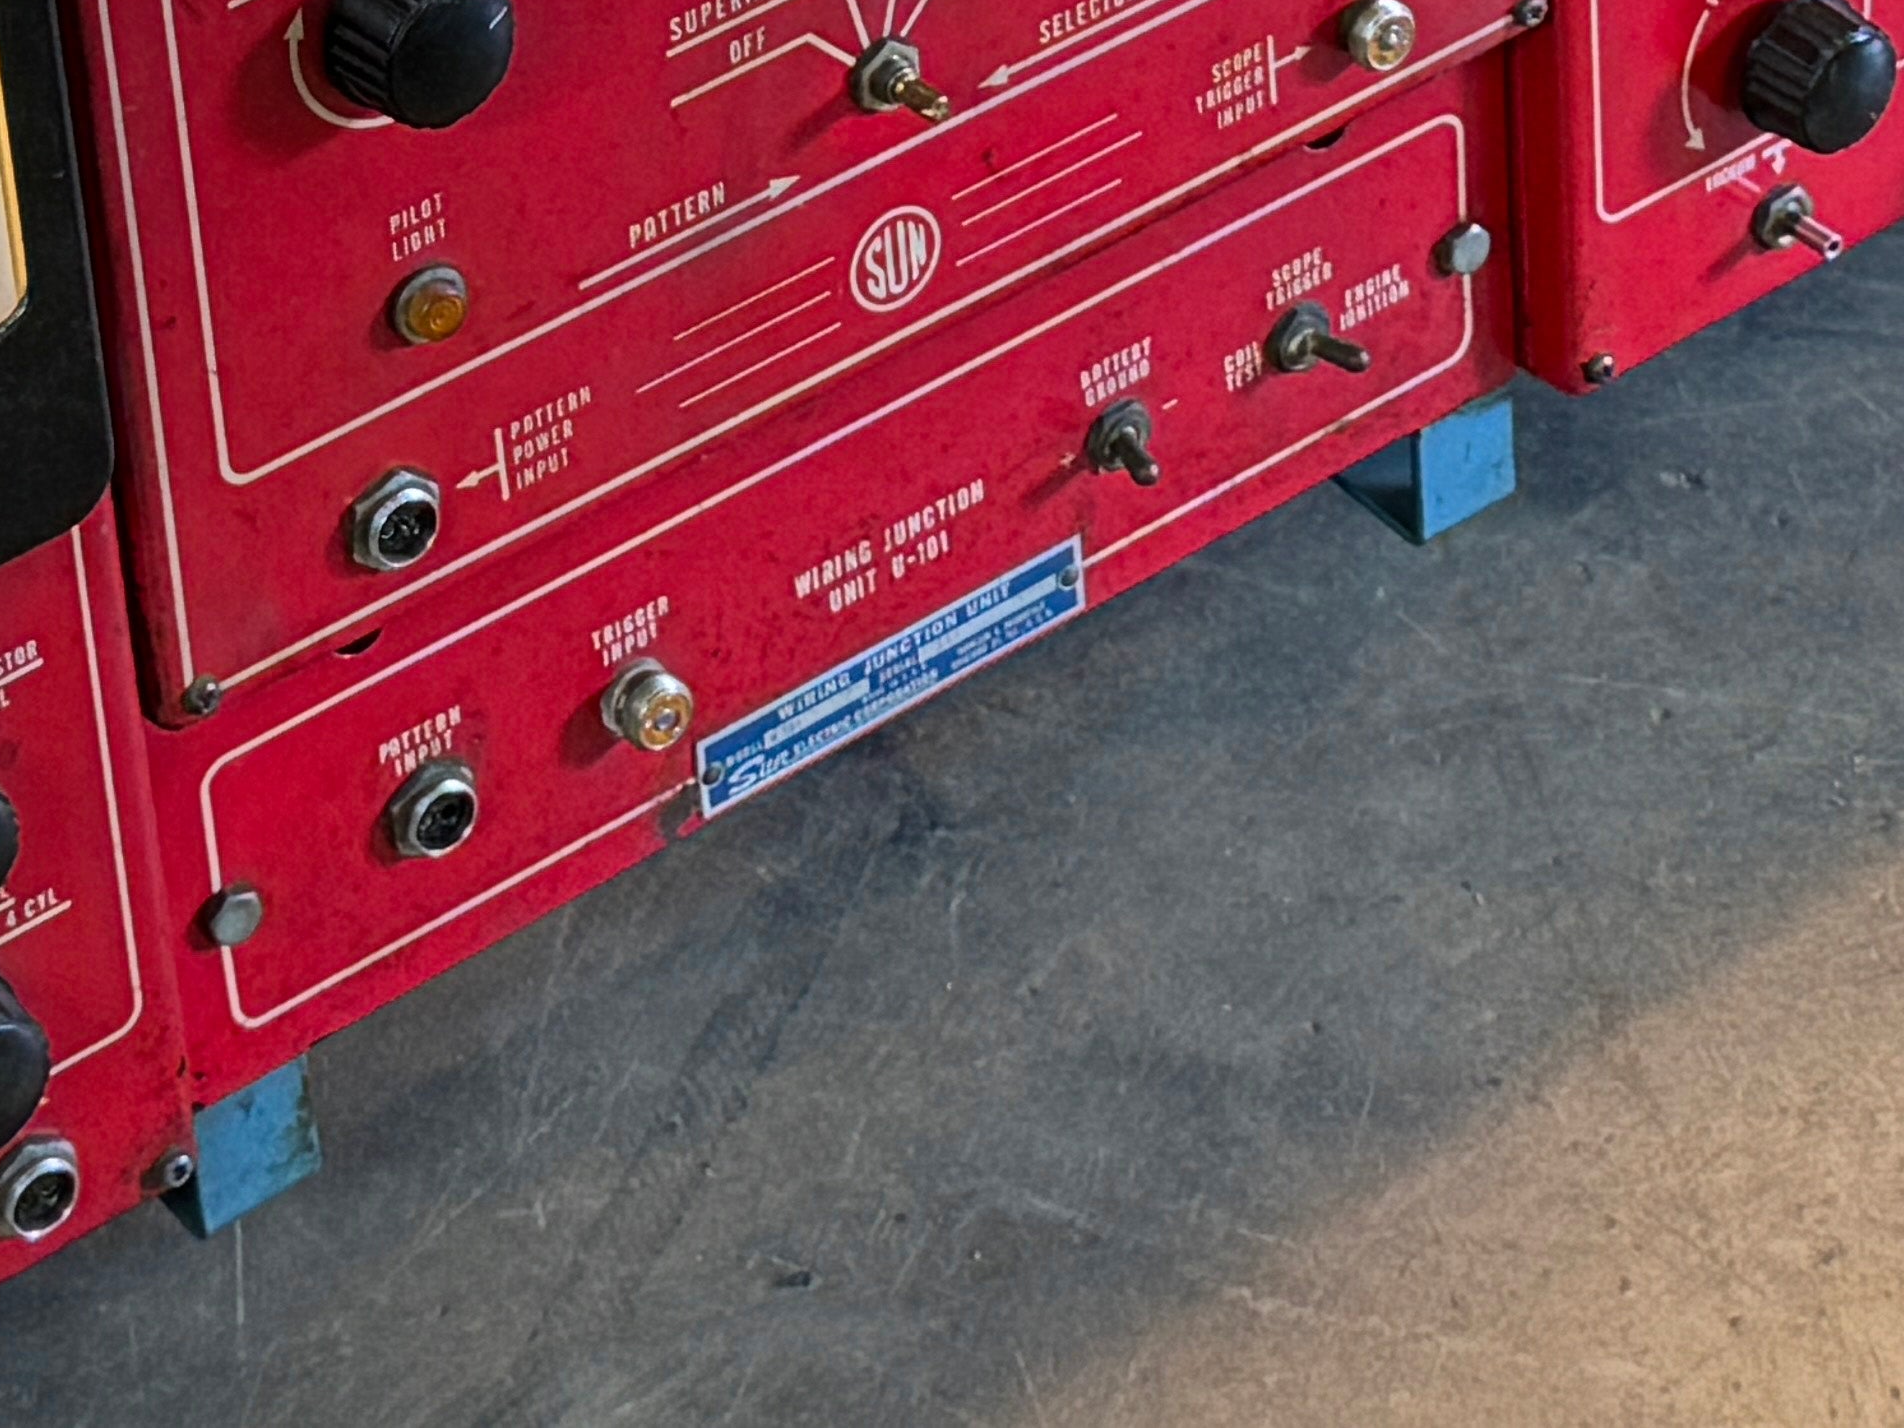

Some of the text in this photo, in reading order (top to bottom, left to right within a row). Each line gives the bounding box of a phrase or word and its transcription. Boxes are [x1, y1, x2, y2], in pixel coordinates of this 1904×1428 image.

[729, 25, 769, 64] OFF
[389, 192, 444, 235] PILOT
[628, 181, 725, 249] PATTERN
[391, 218, 447, 262] LIGHT
[865, 220, 927, 300] SUN
[510, 385, 592, 440] PATTERN
[512, 418, 574, 466] POWER
[516, 448, 569, 491] INPUT
[794, 478, 985, 600] WIRING JUNCTION
[828, 568, 878, 613] UNIT
[591, 595, 669, 650] TRIGGER
[602, 621, 657, 667] INPUT
